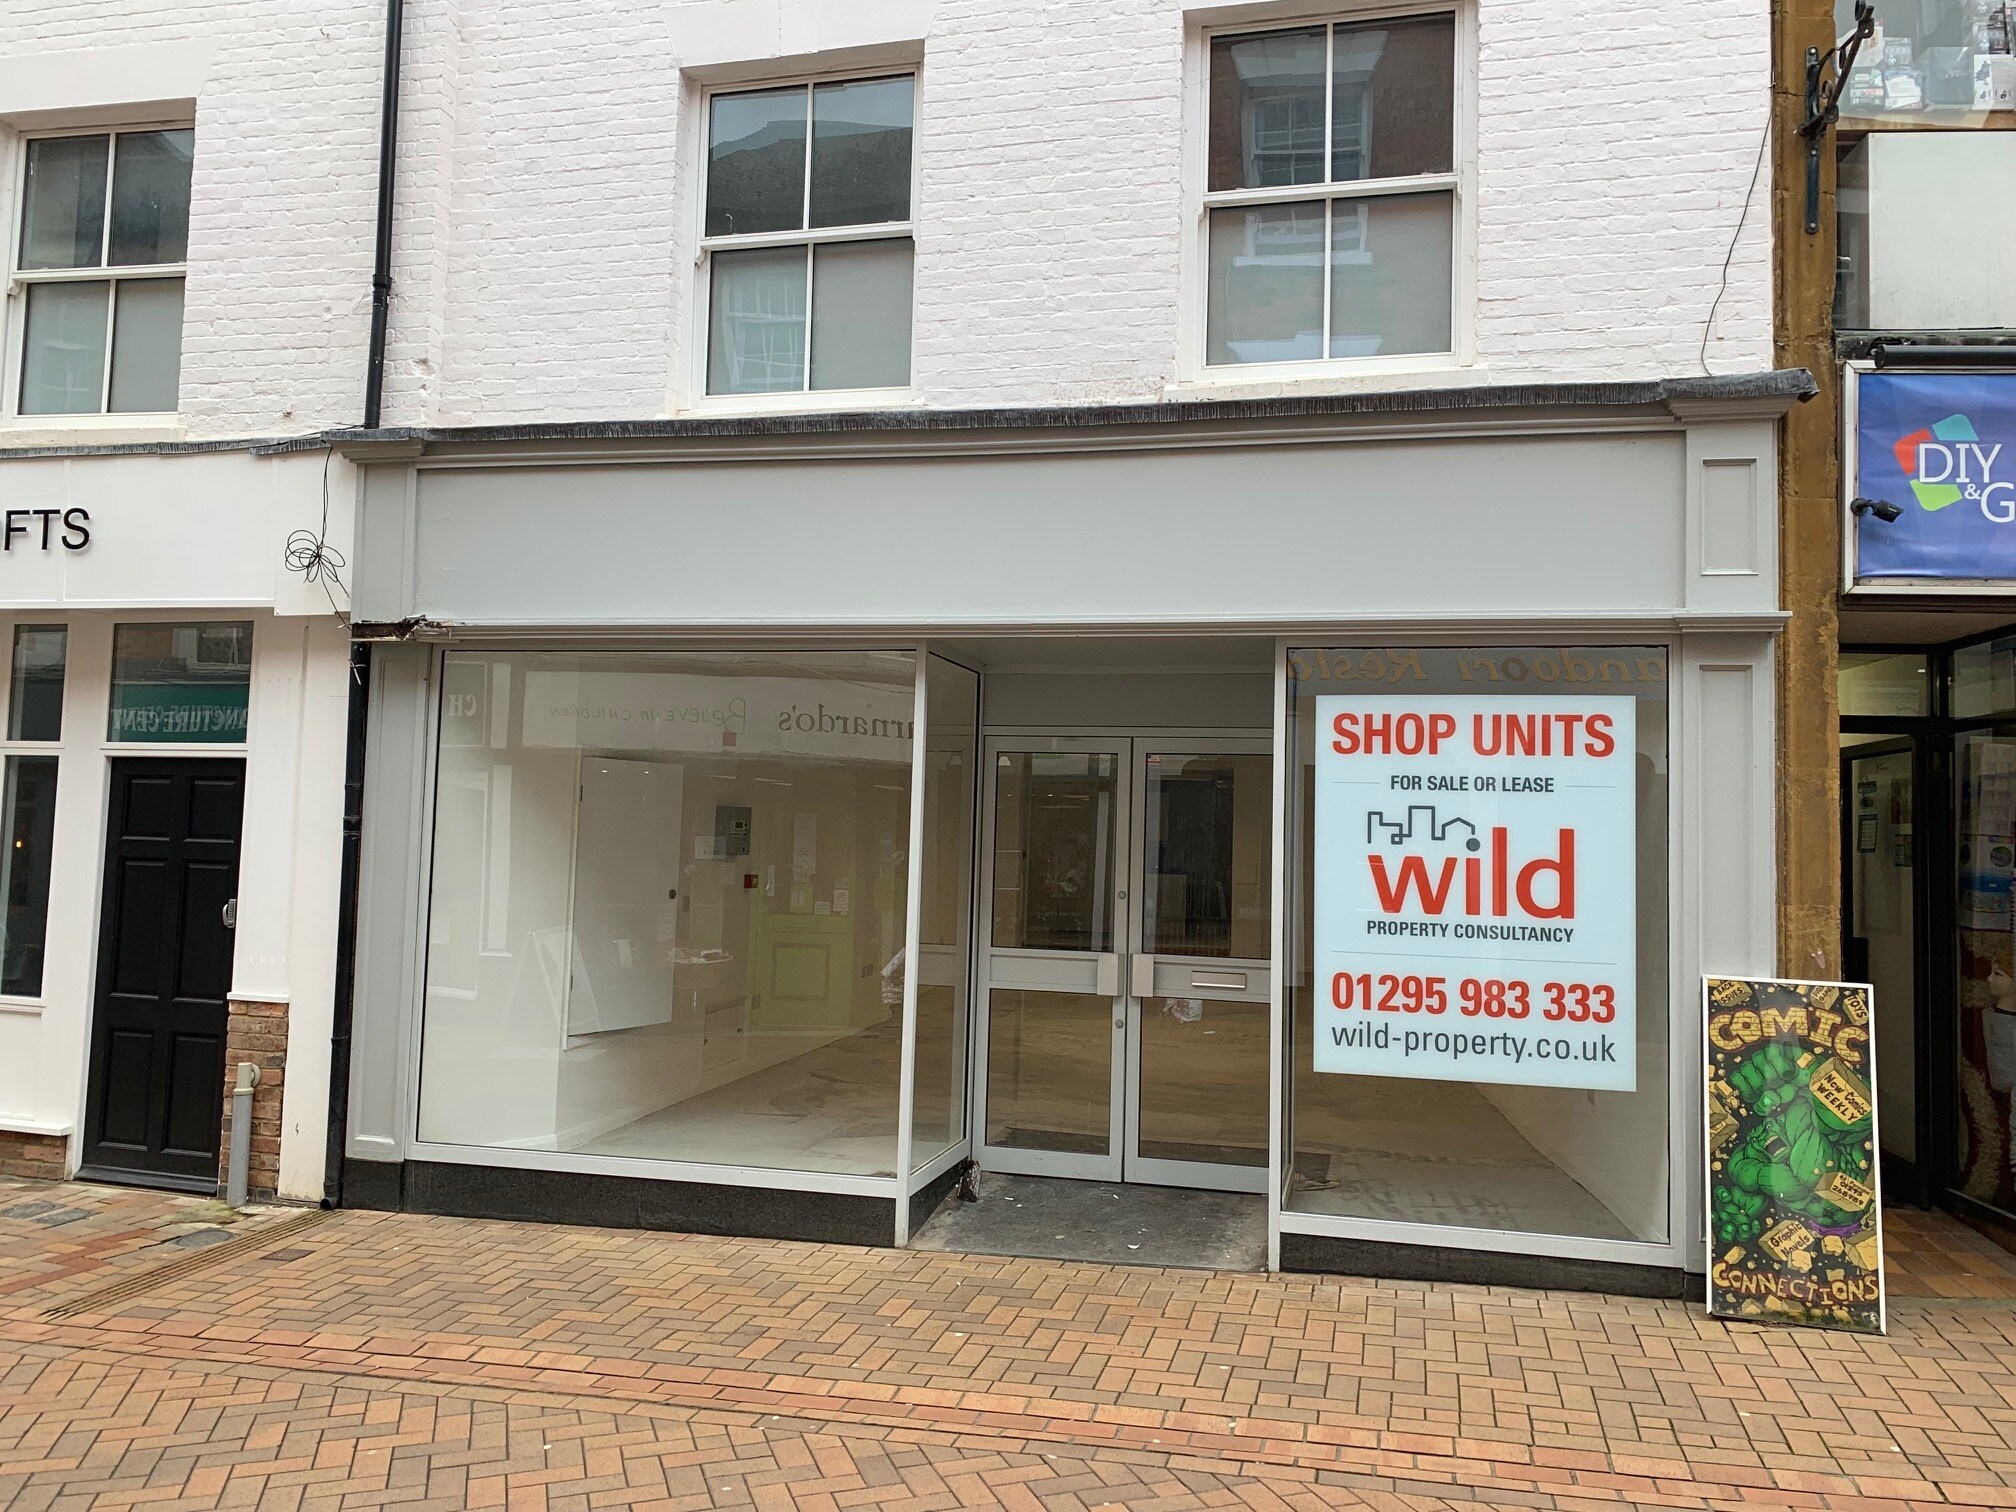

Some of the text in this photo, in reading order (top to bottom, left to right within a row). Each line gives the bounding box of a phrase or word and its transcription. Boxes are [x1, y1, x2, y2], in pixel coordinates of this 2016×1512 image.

[1919, 443, 2002, 483] DIY
[4, 507, 91, 551] FTS
[1331, 712, 1616, 758] SHOP UNITS
[1390, 774, 1555, 793] FOR SALE OR LEASE
[1367, 826, 1575, 919] wild
[1366, 920, 1575, 943] PROPERTY CONSULTANCY
[1331, 971, 1616, 1024] 01295 983 333
[1715, 981, 1734, 996] BACK
[1717, 986, 1743, 1004] ISSUES
[1847, 995, 1867, 1018] TOYS
[1331, 1020, 1617, 1064] wild-property.co.uk
[1709, 1005, 1870, 1063] COMIC
[1816, 1082, 1858, 1121] WEEKLY
[1770, 1222, 1803, 1247] Graphic
[1781, 1234, 1810, 1258] Novels
[1712, 1261, 1879, 1305] CONNECTIONS
